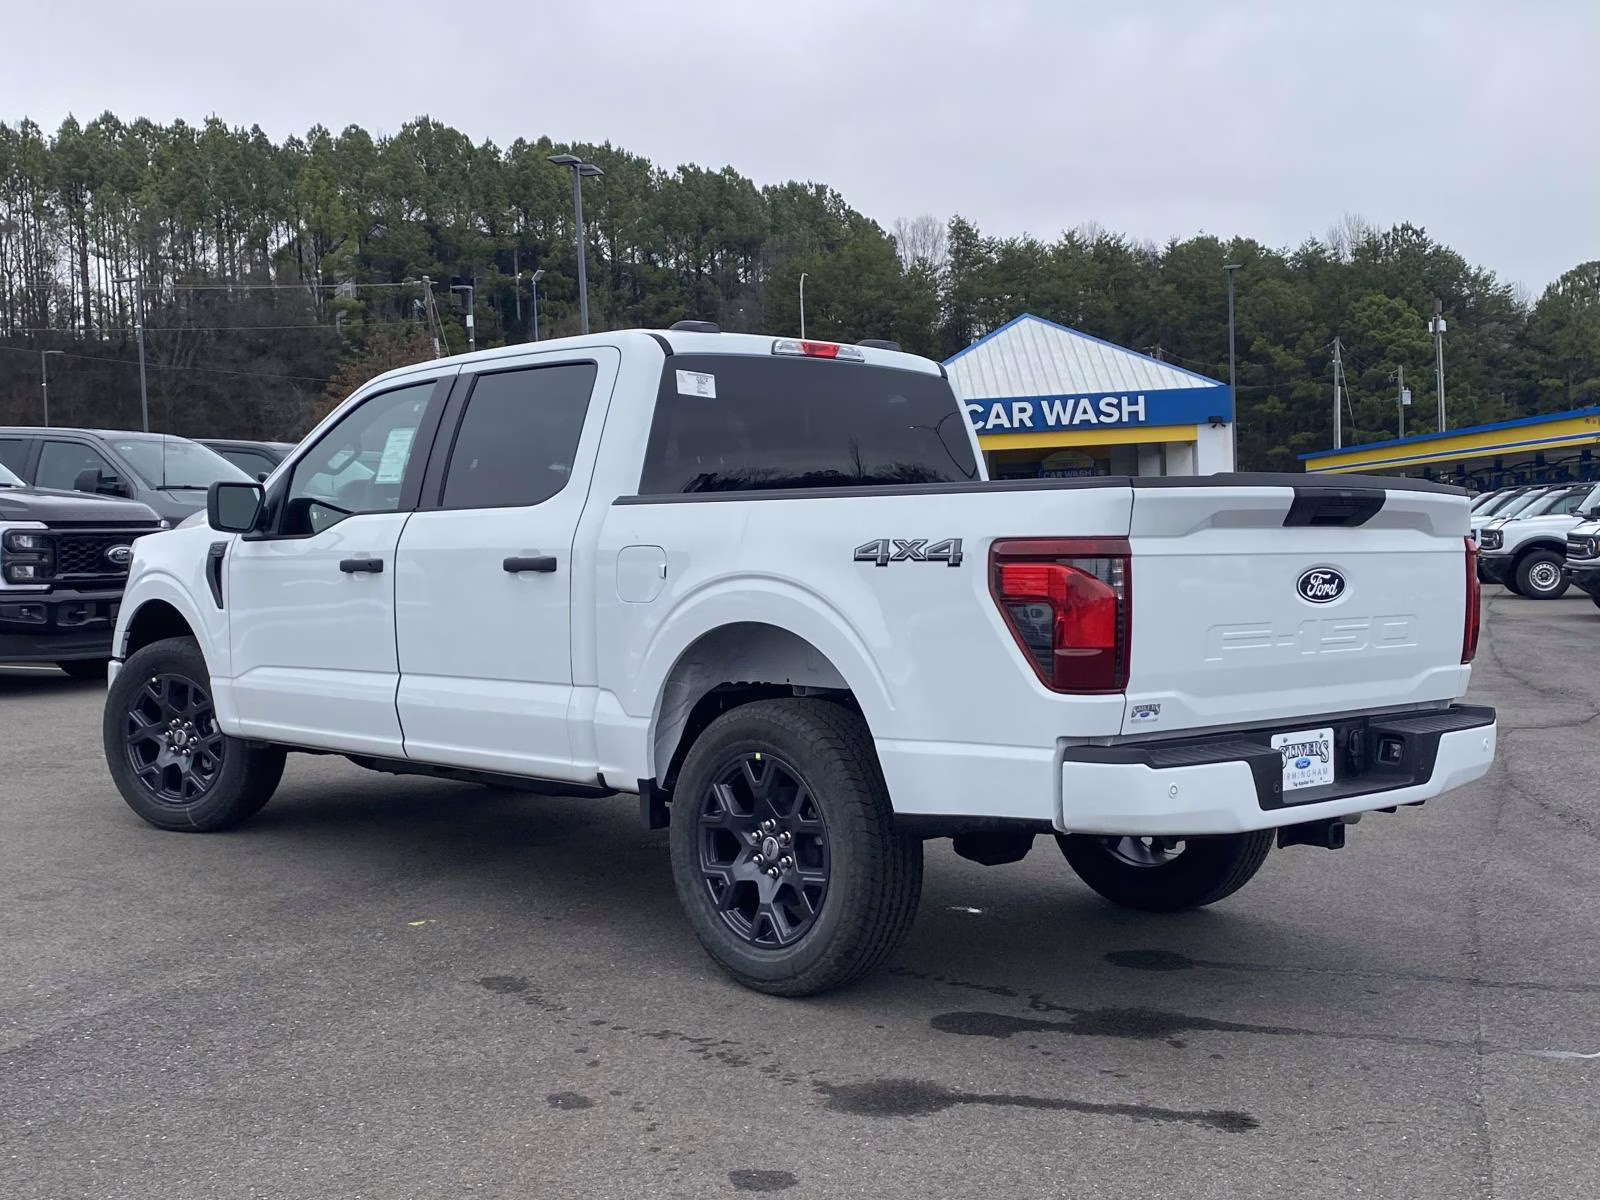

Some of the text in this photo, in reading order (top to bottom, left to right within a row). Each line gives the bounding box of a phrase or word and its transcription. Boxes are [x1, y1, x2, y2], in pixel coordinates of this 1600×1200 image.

[966, 395, 1146, 430] CAR WASH
[1064, 469, 1092, 477] WASH
[1307, 573, 1338, 597] Ford
[1204, 614, 1419, 662] F-150
[1279, 740, 1329, 769] STIVERS
